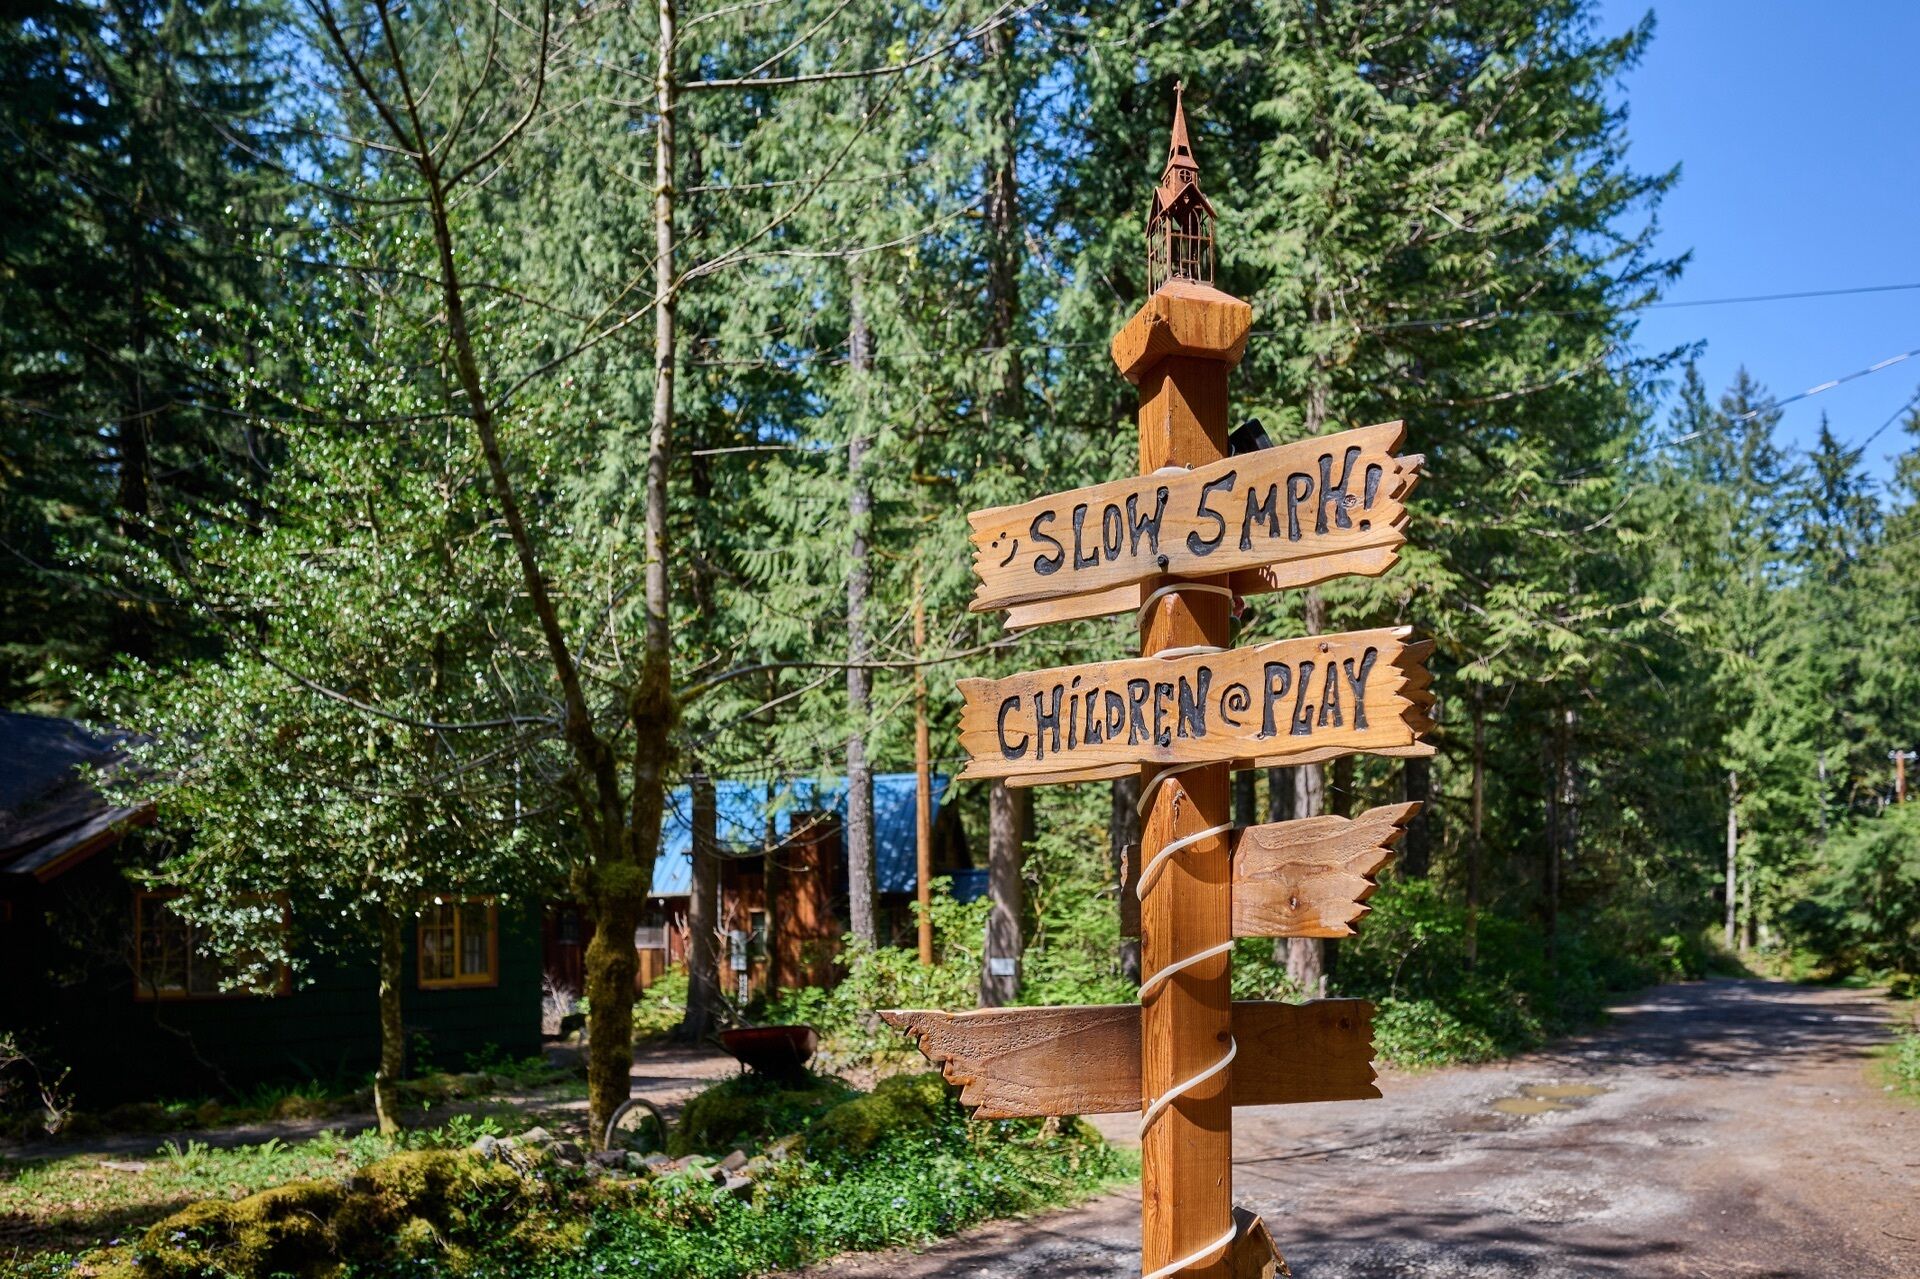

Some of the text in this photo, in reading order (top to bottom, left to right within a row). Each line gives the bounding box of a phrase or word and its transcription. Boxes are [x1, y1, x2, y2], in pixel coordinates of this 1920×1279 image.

[1029, 445, 1383, 576] SLOW 5 MPH!
[1219, 682, 1252, 728] @
[1259, 646, 1378, 741] PLAY
